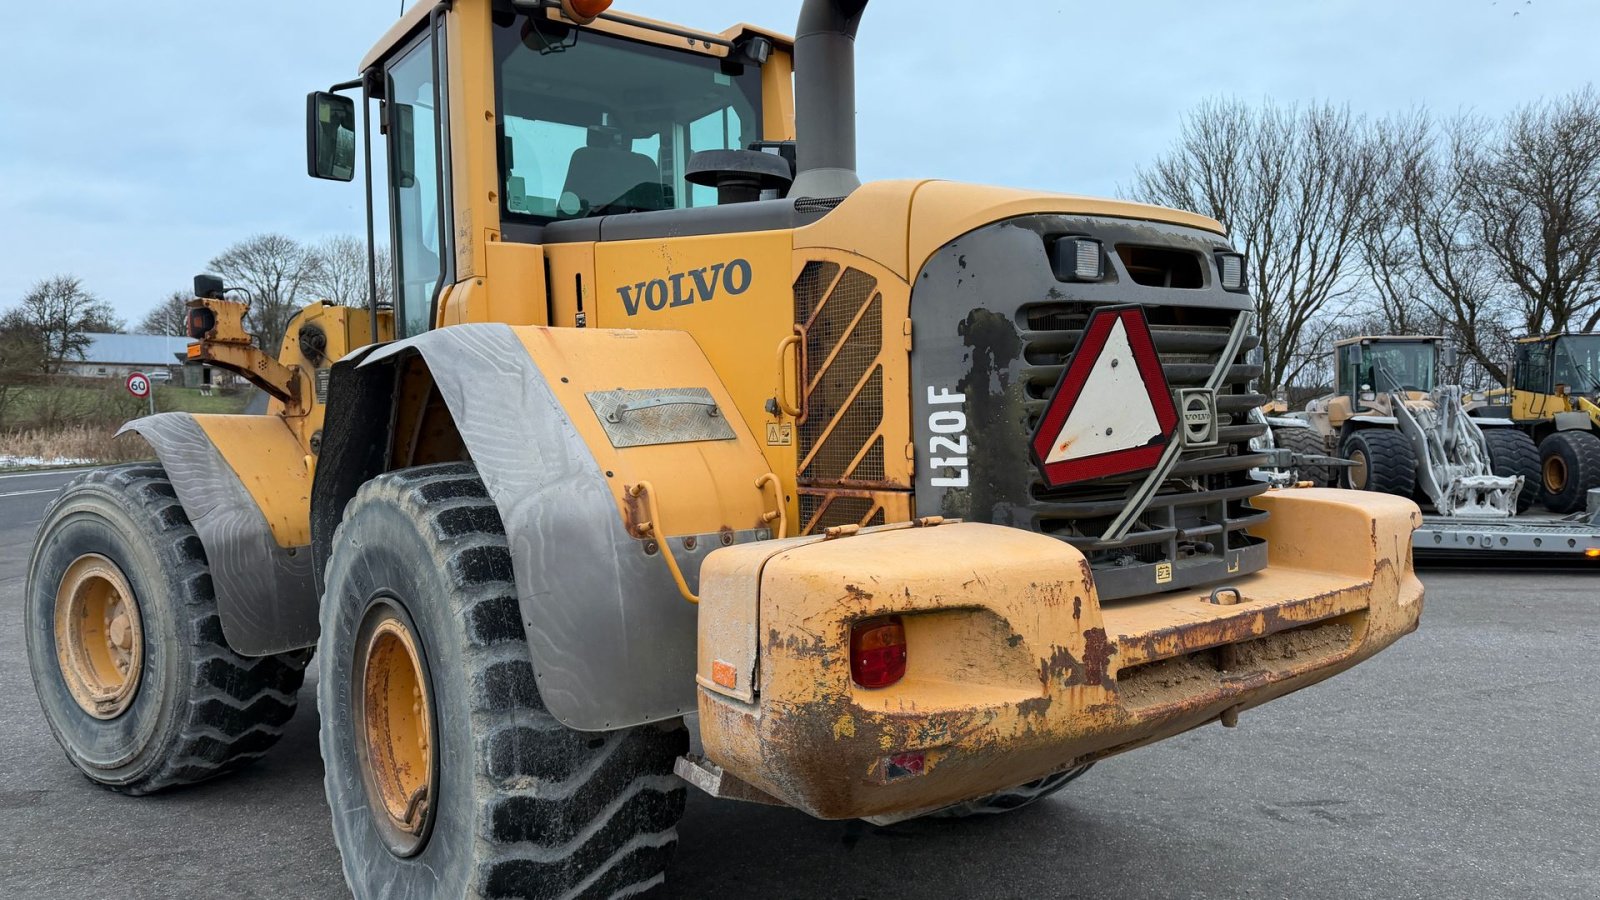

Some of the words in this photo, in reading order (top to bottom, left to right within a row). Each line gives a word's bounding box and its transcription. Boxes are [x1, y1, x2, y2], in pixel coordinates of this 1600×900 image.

[616, 258, 752, 317] VOLVO
[131, 380, 146, 391] 60
[1184, 413, 1211, 421] VOLVO
